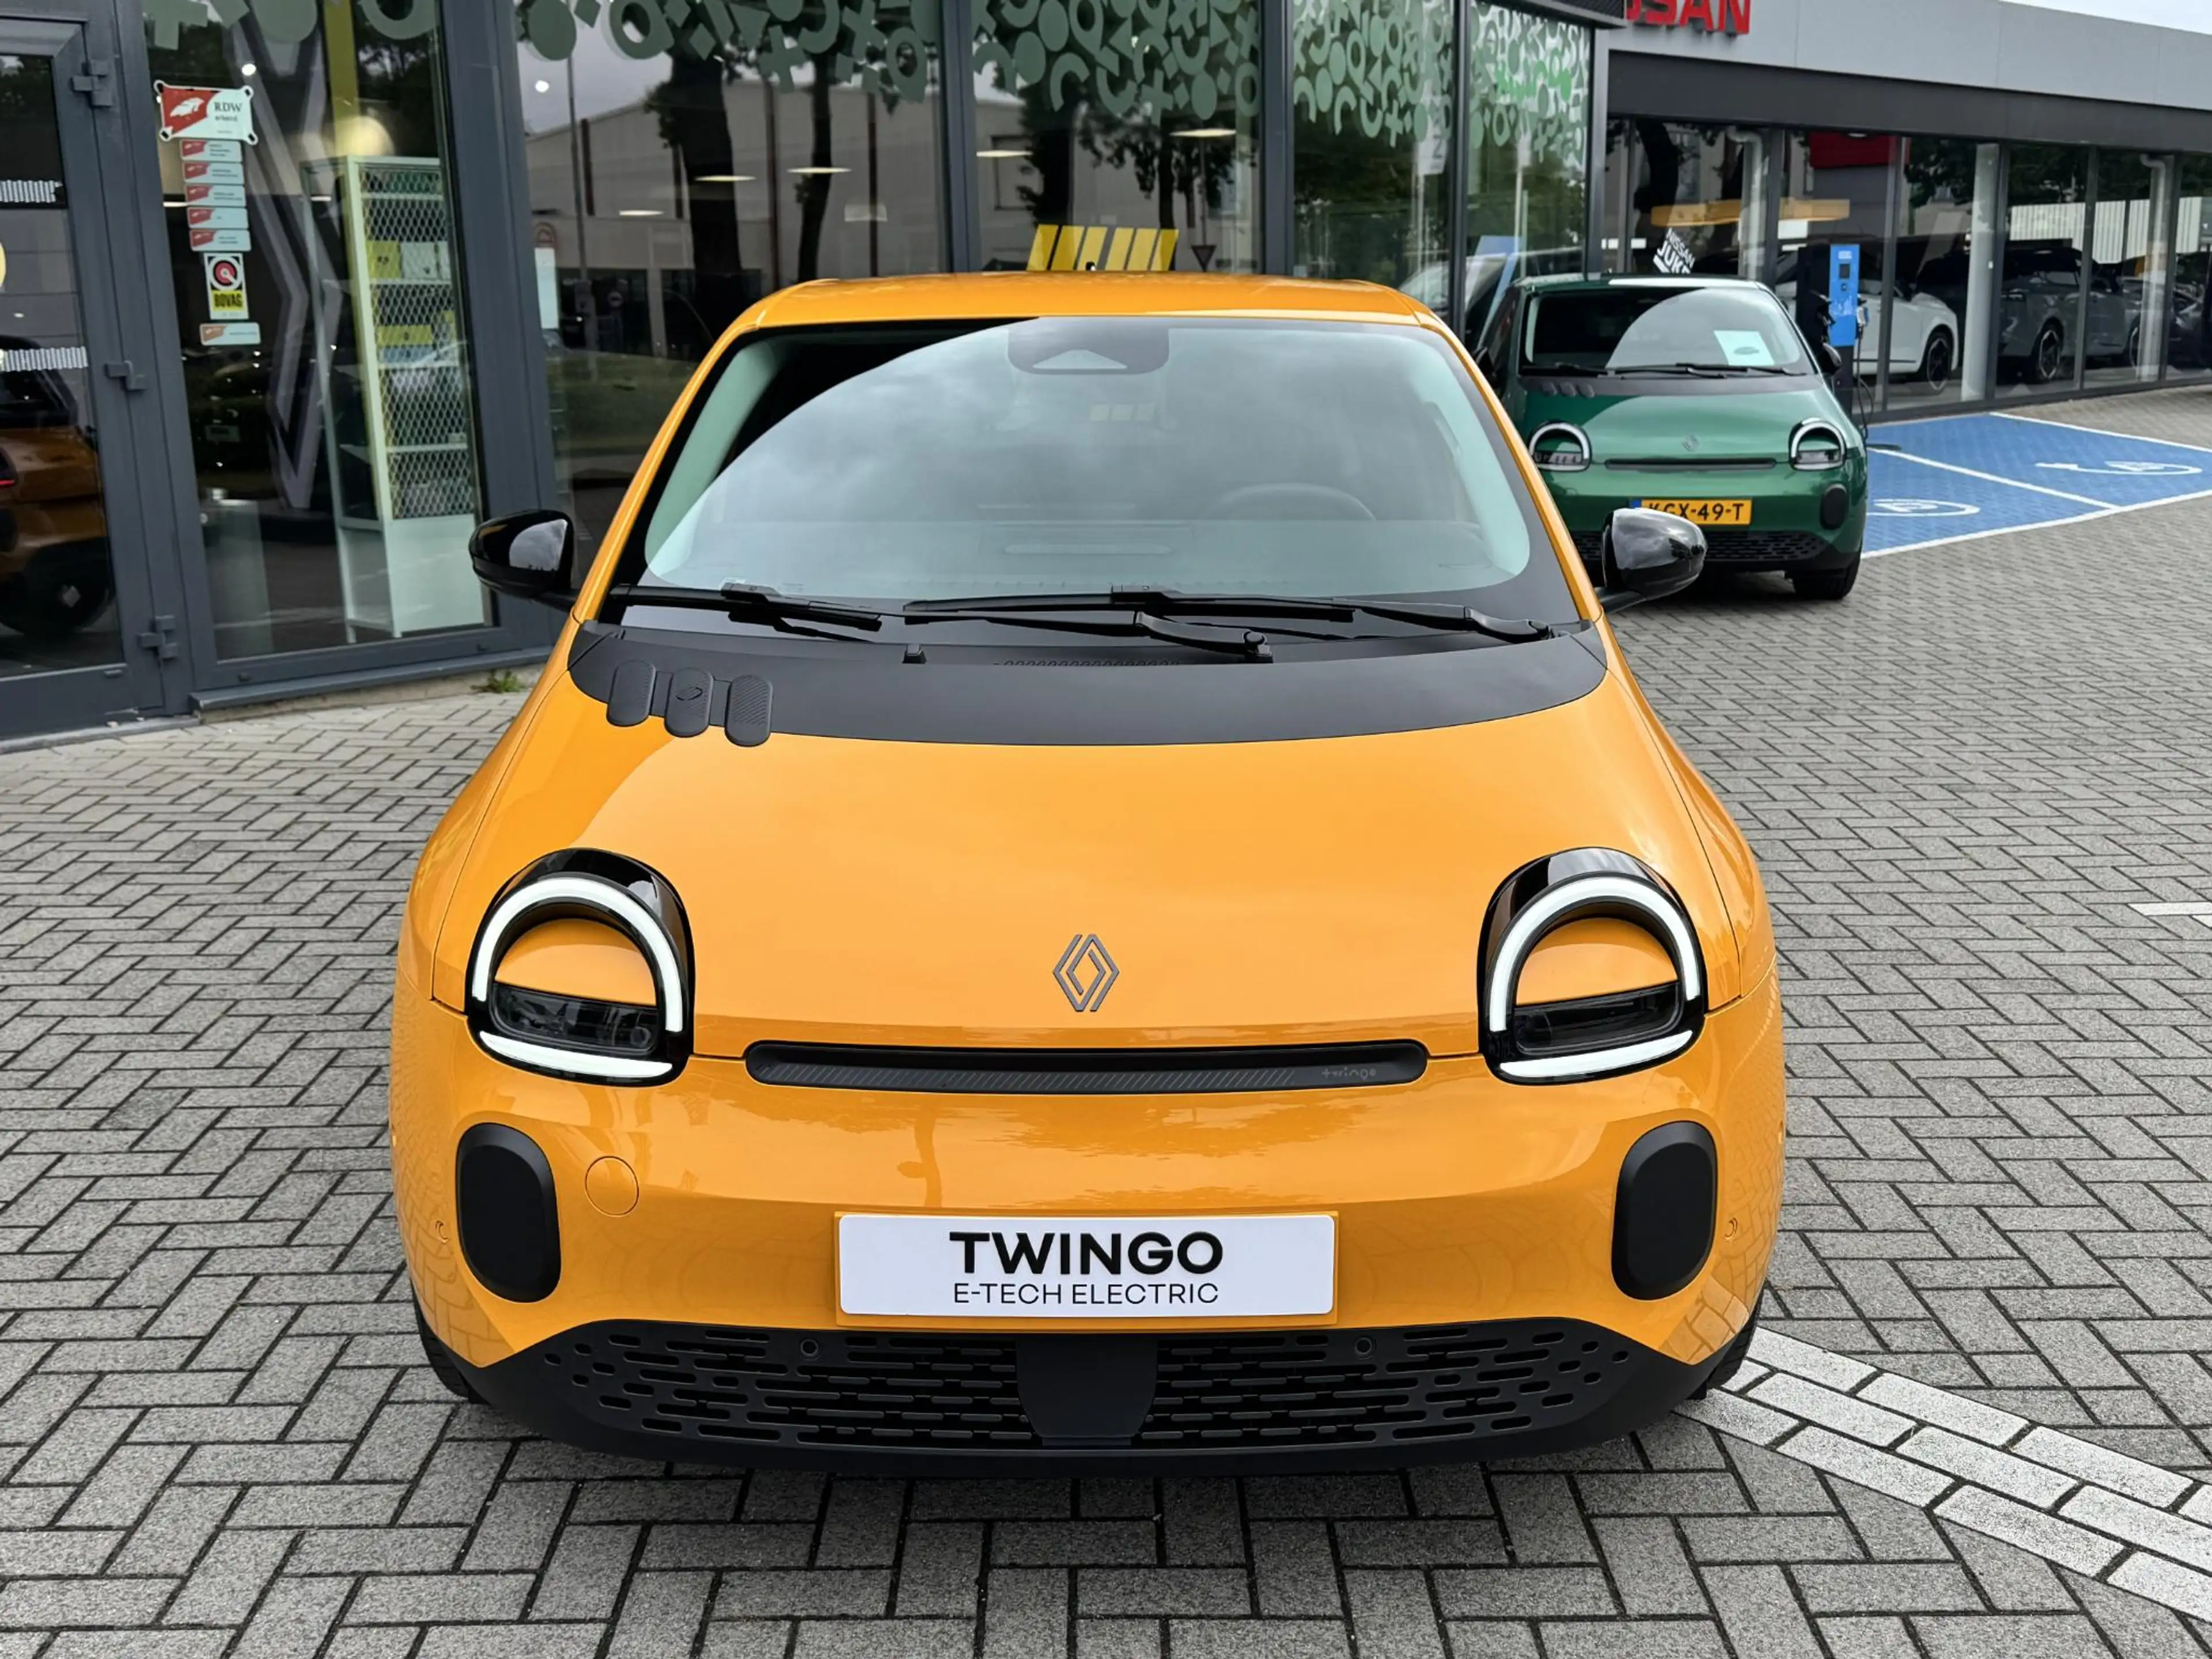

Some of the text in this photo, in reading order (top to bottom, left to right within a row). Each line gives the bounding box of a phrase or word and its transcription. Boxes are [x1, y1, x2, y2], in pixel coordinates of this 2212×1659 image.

[214, 101, 243, 112] RDW
[214, 293, 243, 308] BOVAG
[950, 1232, 1222, 1275] TWINGO
[955, 1283, 1218, 1304] E-TECH ELECTRIC
